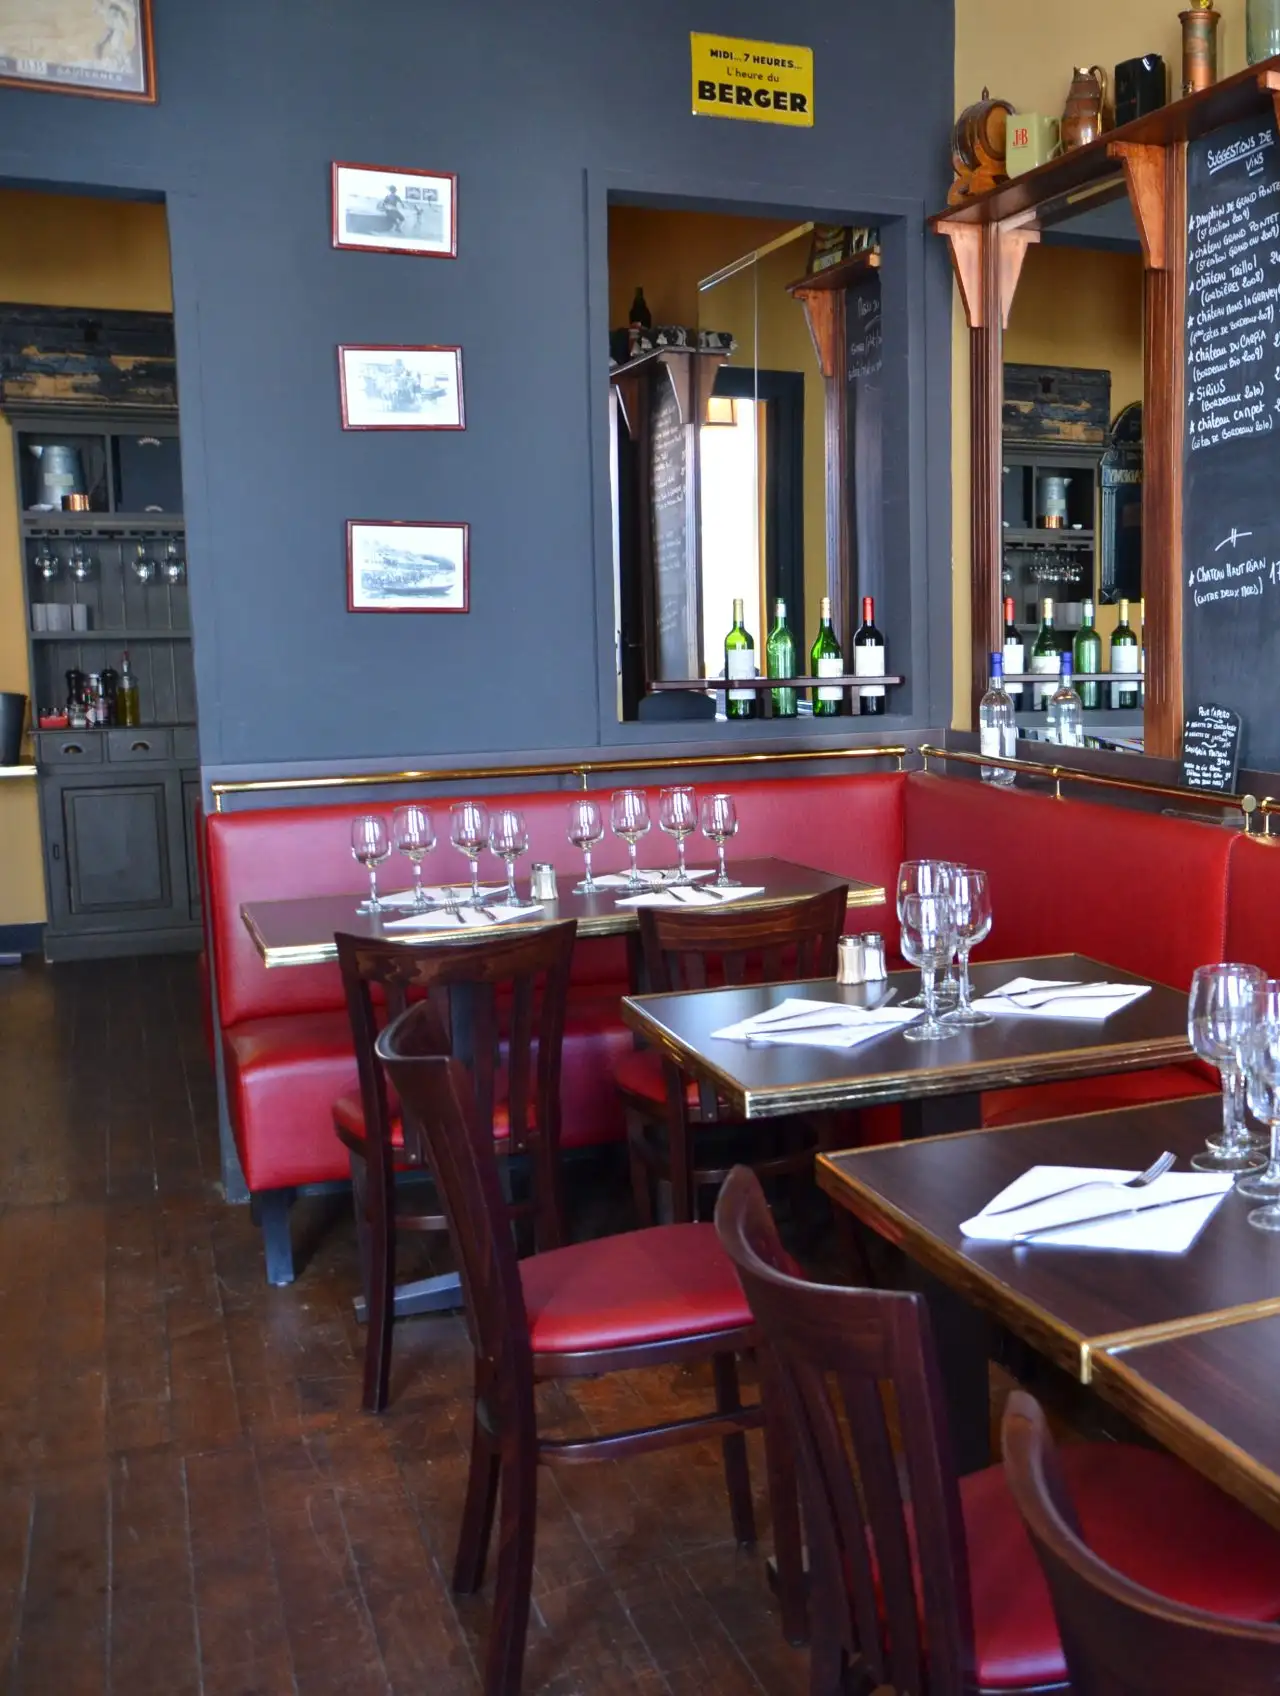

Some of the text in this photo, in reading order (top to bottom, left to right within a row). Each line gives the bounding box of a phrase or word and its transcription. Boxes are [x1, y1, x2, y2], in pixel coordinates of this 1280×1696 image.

[744, 53, 750, 62] 7
[726, 66, 780, 83] L'heure du
[698, 79, 807, 113] BERGER
[1258, 129, 1272, 144] DE
[1245, 152, 1264, 171] VINS
[1223, 229, 1247, 246] GRAND
[1249, 212, 1280, 232] PONTET
